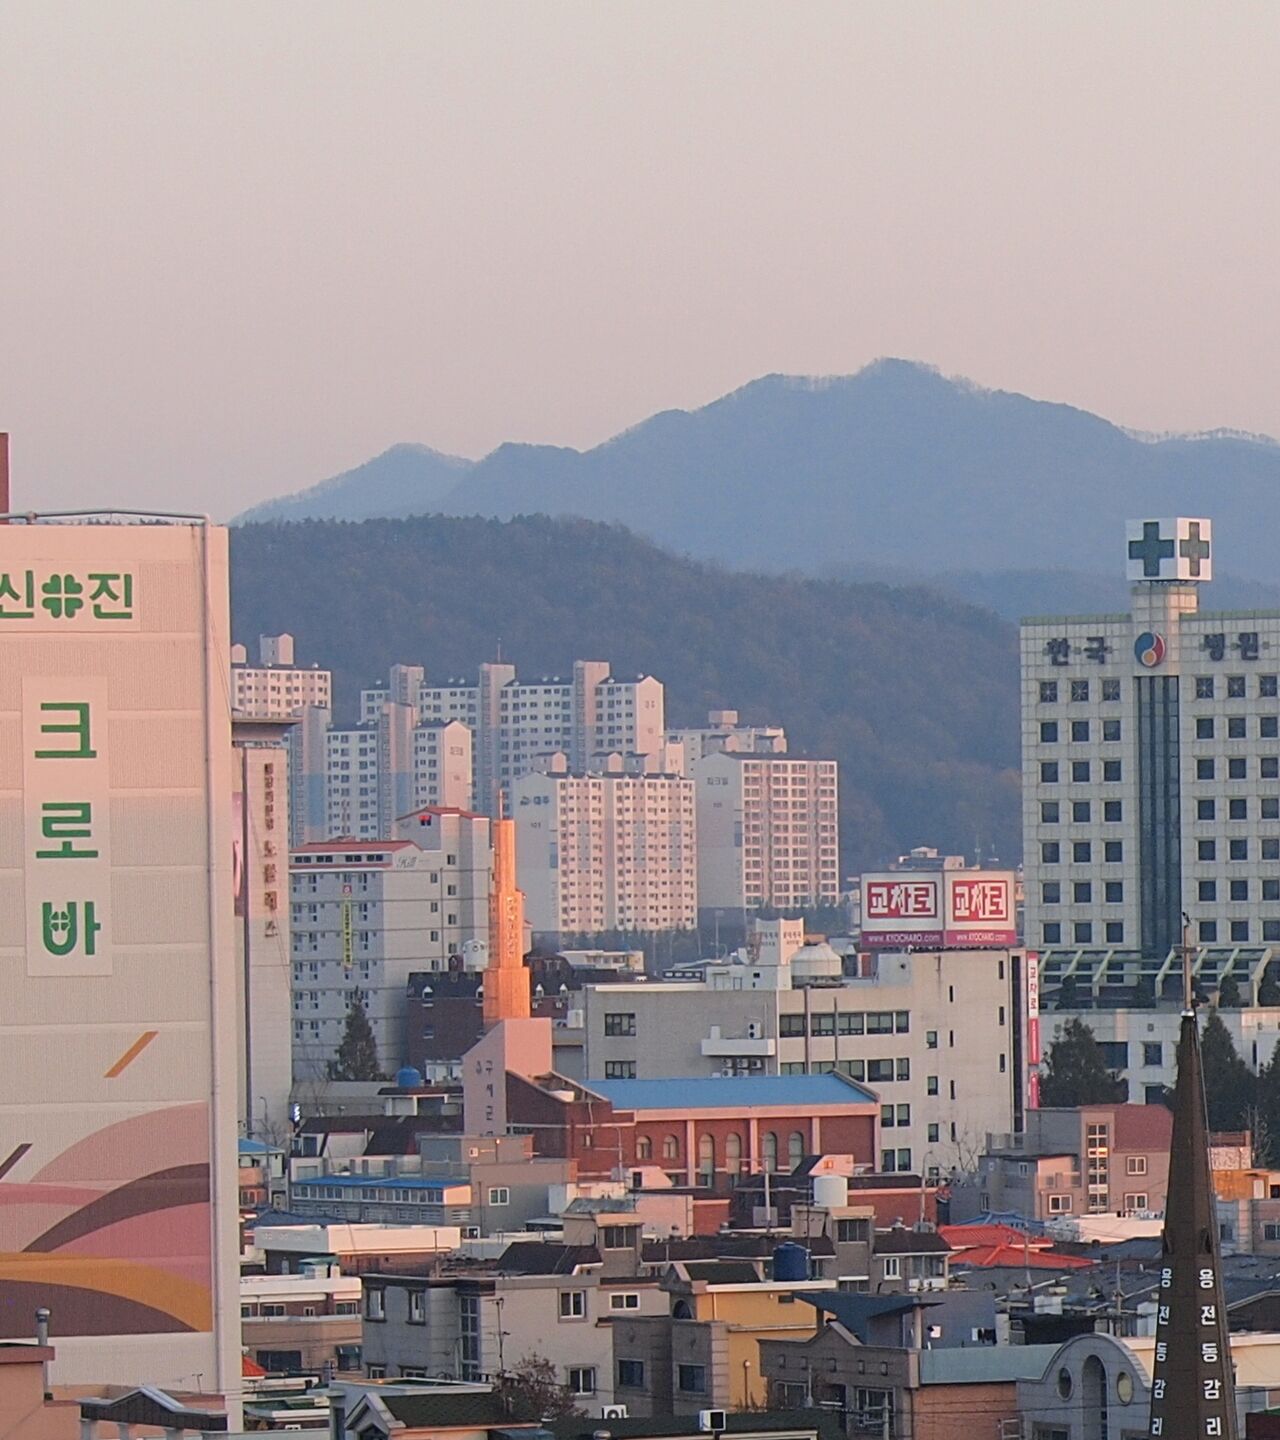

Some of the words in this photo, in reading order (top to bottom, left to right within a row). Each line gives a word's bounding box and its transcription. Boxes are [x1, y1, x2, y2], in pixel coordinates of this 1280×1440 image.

[1047, 636, 1109, 665] 한국
[1203, 632, 1260, 661] 병원
[35, 702, 101, 956] 크로바
[869, 884, 936, 917] 교차로
[954, 882, 1007, 919] 교차로
[868, 933, 940, 943] www.KYOCHARO.com
